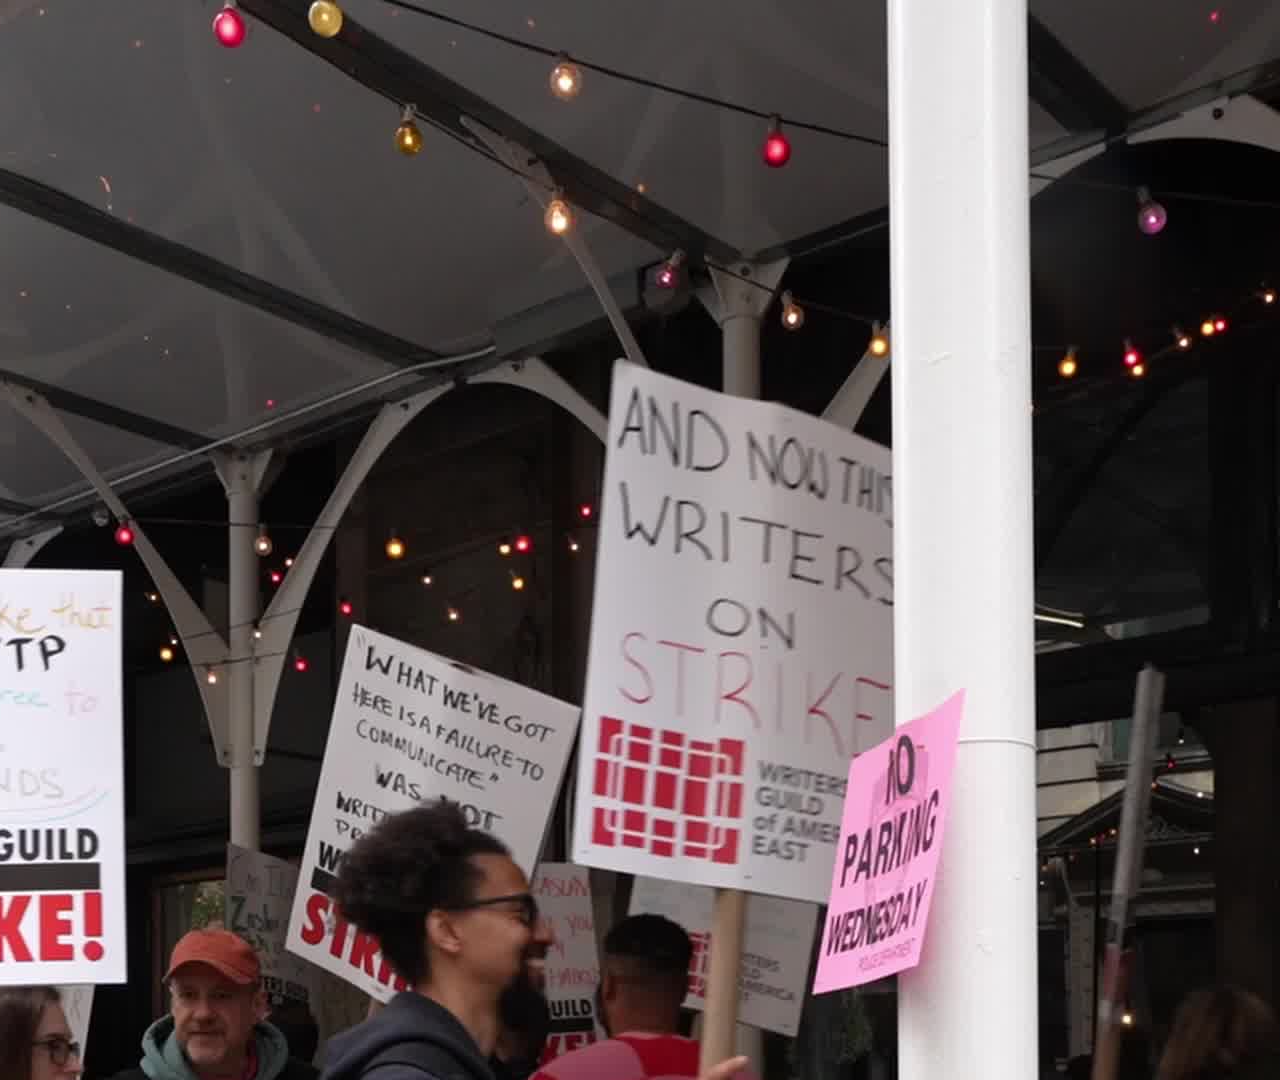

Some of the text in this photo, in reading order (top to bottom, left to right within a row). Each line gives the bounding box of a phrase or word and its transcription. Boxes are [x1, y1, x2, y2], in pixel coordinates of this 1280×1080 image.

[618, 386, 729, 472] AND
[746, 431, 828, 500] NOW
[706, 598, 795, 649] ON
[64, 686, 98, 716] to
[443, 684, 501, 726] WE'VE
[503, 714, 556, 743] GOT
[618, 631, 891, 760] STRIKE
[353, 682, 393, 717] HERE
[399, 706, 417, 727] IS
[435, 724, 513, 768] FAILURE
[516, 757, 544, 781] TO
[375, 763, 503, 831] WAS OT
[753, 814, 778, 832] of
[756, 786, 824, 816] GUILD
[752, 836, 809, 863] EAST
[840, 789, 939, 888] PARKING
[826, 878, 928, 957] WEDNESDAY
[551, 999, 593, 1018] UILD
